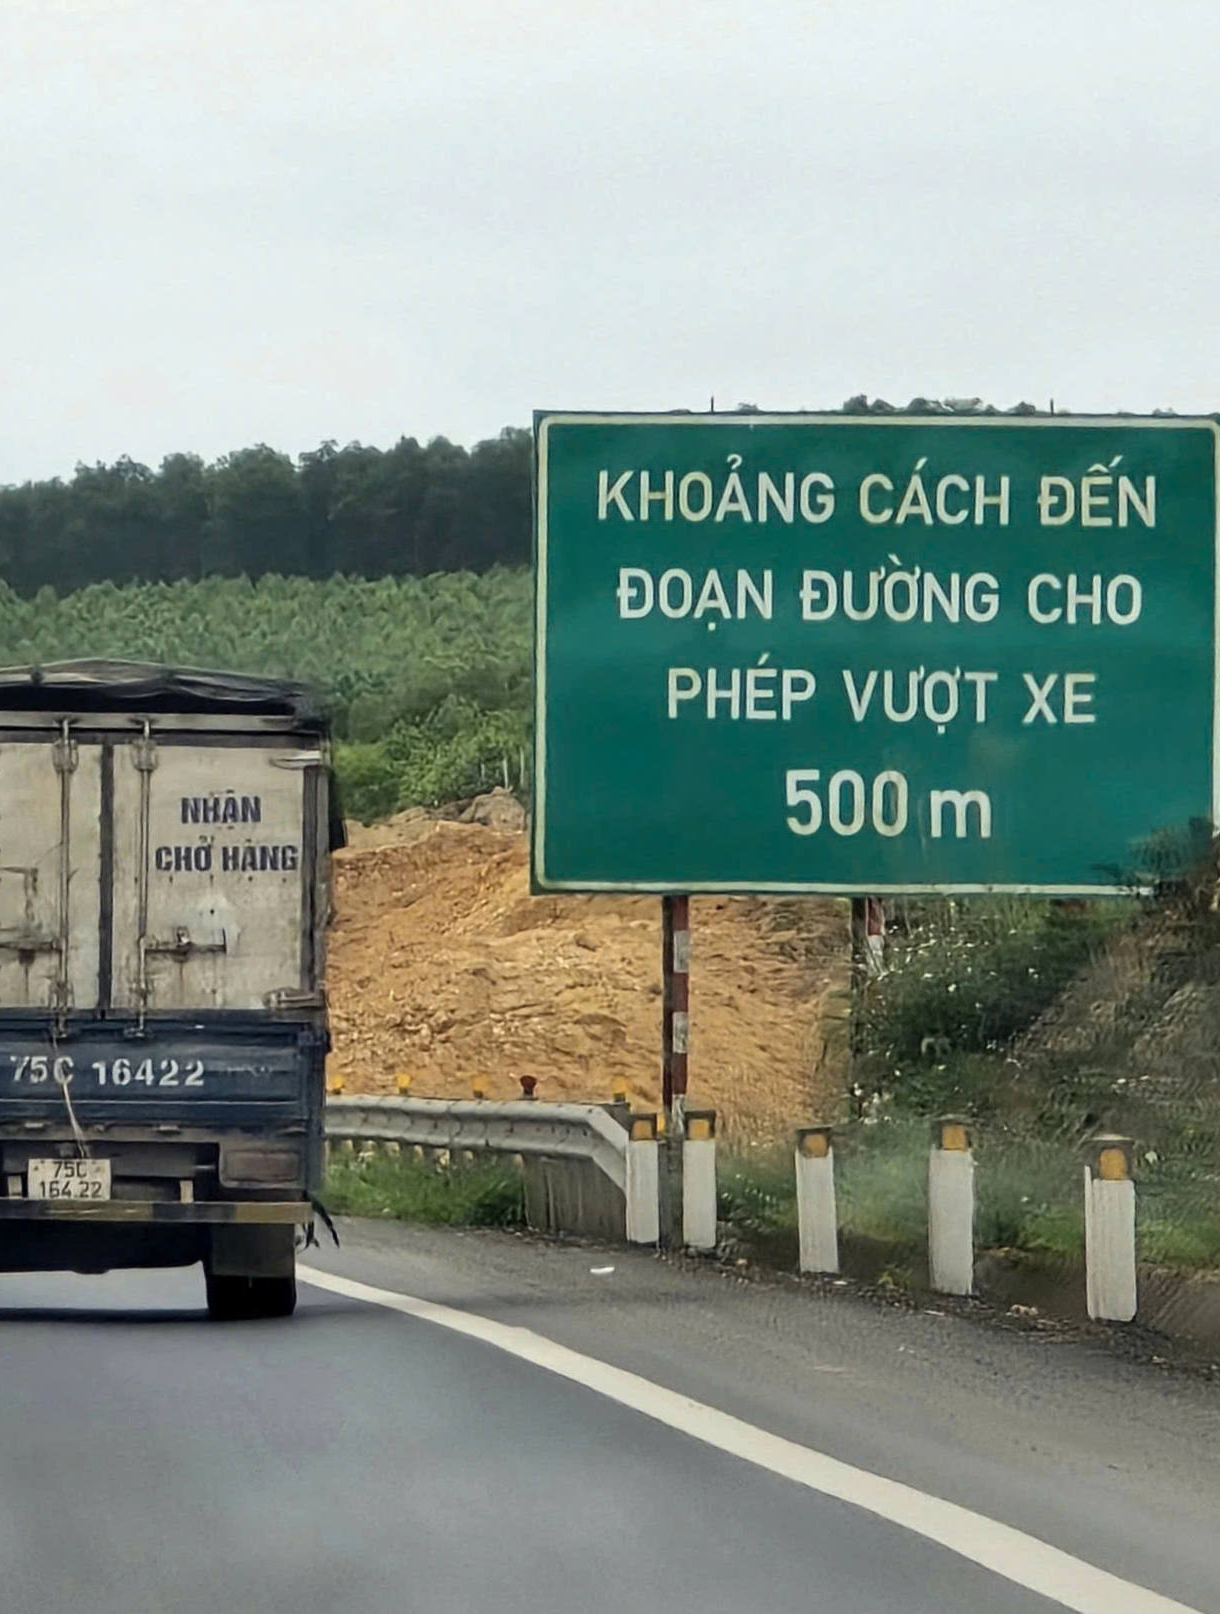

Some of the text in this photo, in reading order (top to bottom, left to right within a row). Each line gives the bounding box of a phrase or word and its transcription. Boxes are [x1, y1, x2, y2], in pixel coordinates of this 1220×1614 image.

[597, 453, 1156, 528] KHOẢNG CÁCH ĐẾN
[616, 554, 1142, 631] ĐOẠN ĐƯỜNG CHO
[667, 652, 1096, 735] PHÉP VƯỢT XE
[785, 768, 992, 839] 500 m
[9, 1055, 205, 1087] 75C 16422
[52, 1161, 88, 1179] 75C
